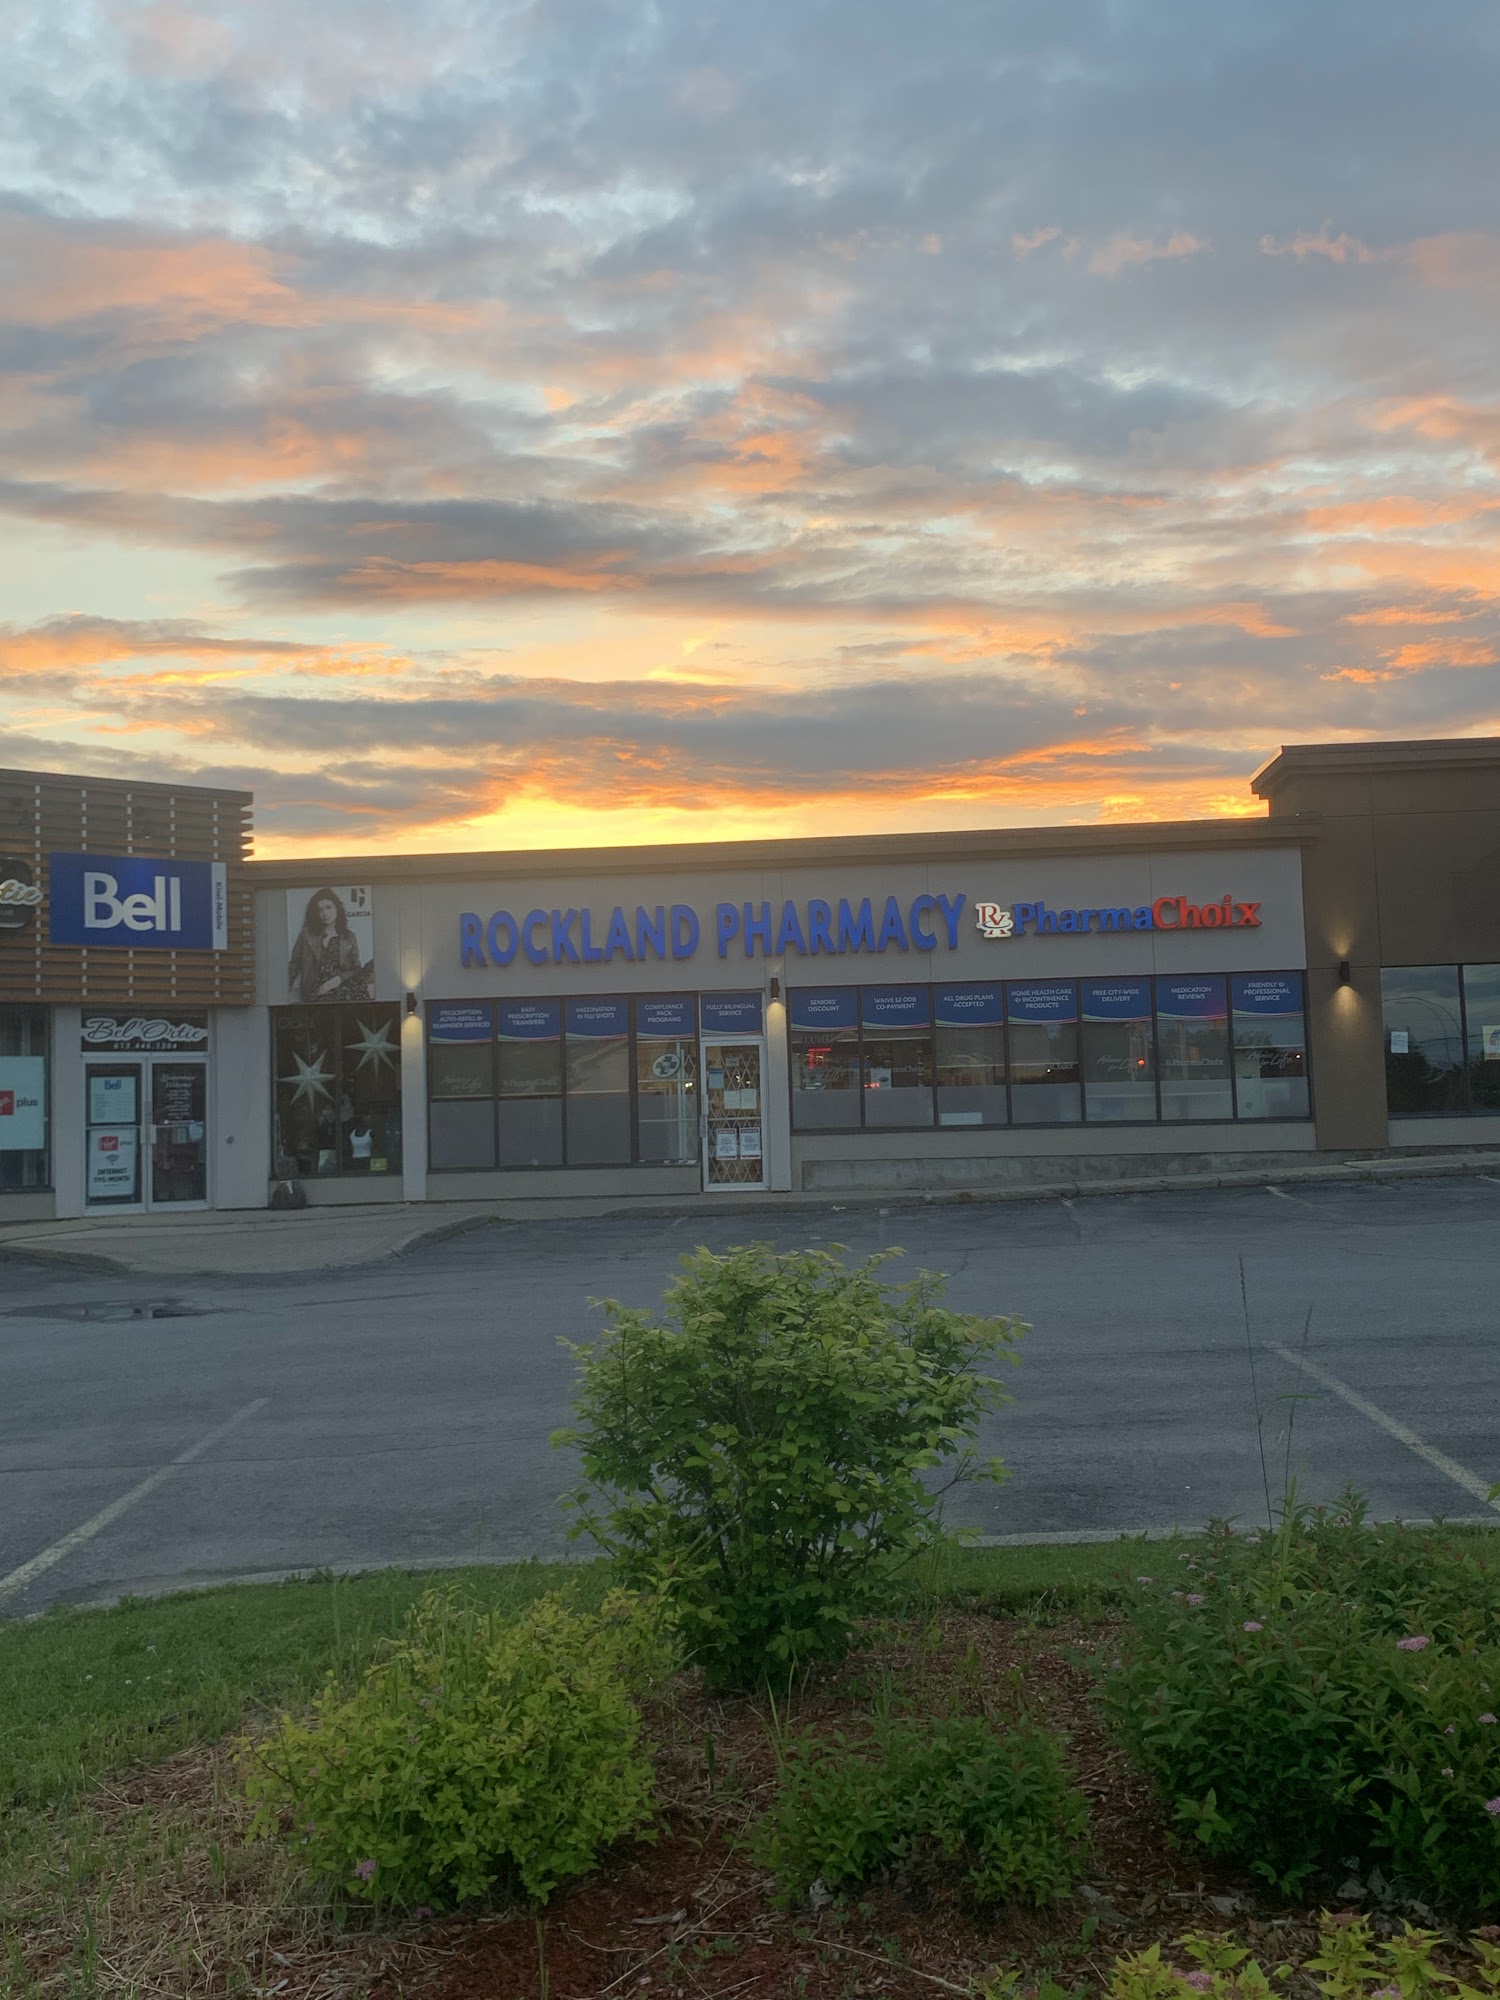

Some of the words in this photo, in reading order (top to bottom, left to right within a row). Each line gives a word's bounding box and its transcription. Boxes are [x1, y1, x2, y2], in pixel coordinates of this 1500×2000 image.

[0, 879, 42, 904] tie
[84, 872, 181, 931] Bell
[1012, 895, 1263, 935] PharmaChoix
[460, 904, 700, 967] ROCKLAND
[716, 893, 967, 958] PHARMACY
[575, 1006, 616, 1014] VACCINATION
[644, 1003, 684, 1011] COMPLIANCE
[507, 1012, 550, 1020] PRESCRIPTION
[463, 1020, 490, 1028] SERVICES
[105, 1080, 122, 1090] Bell
[16, 1096, 39, 1108] plus
